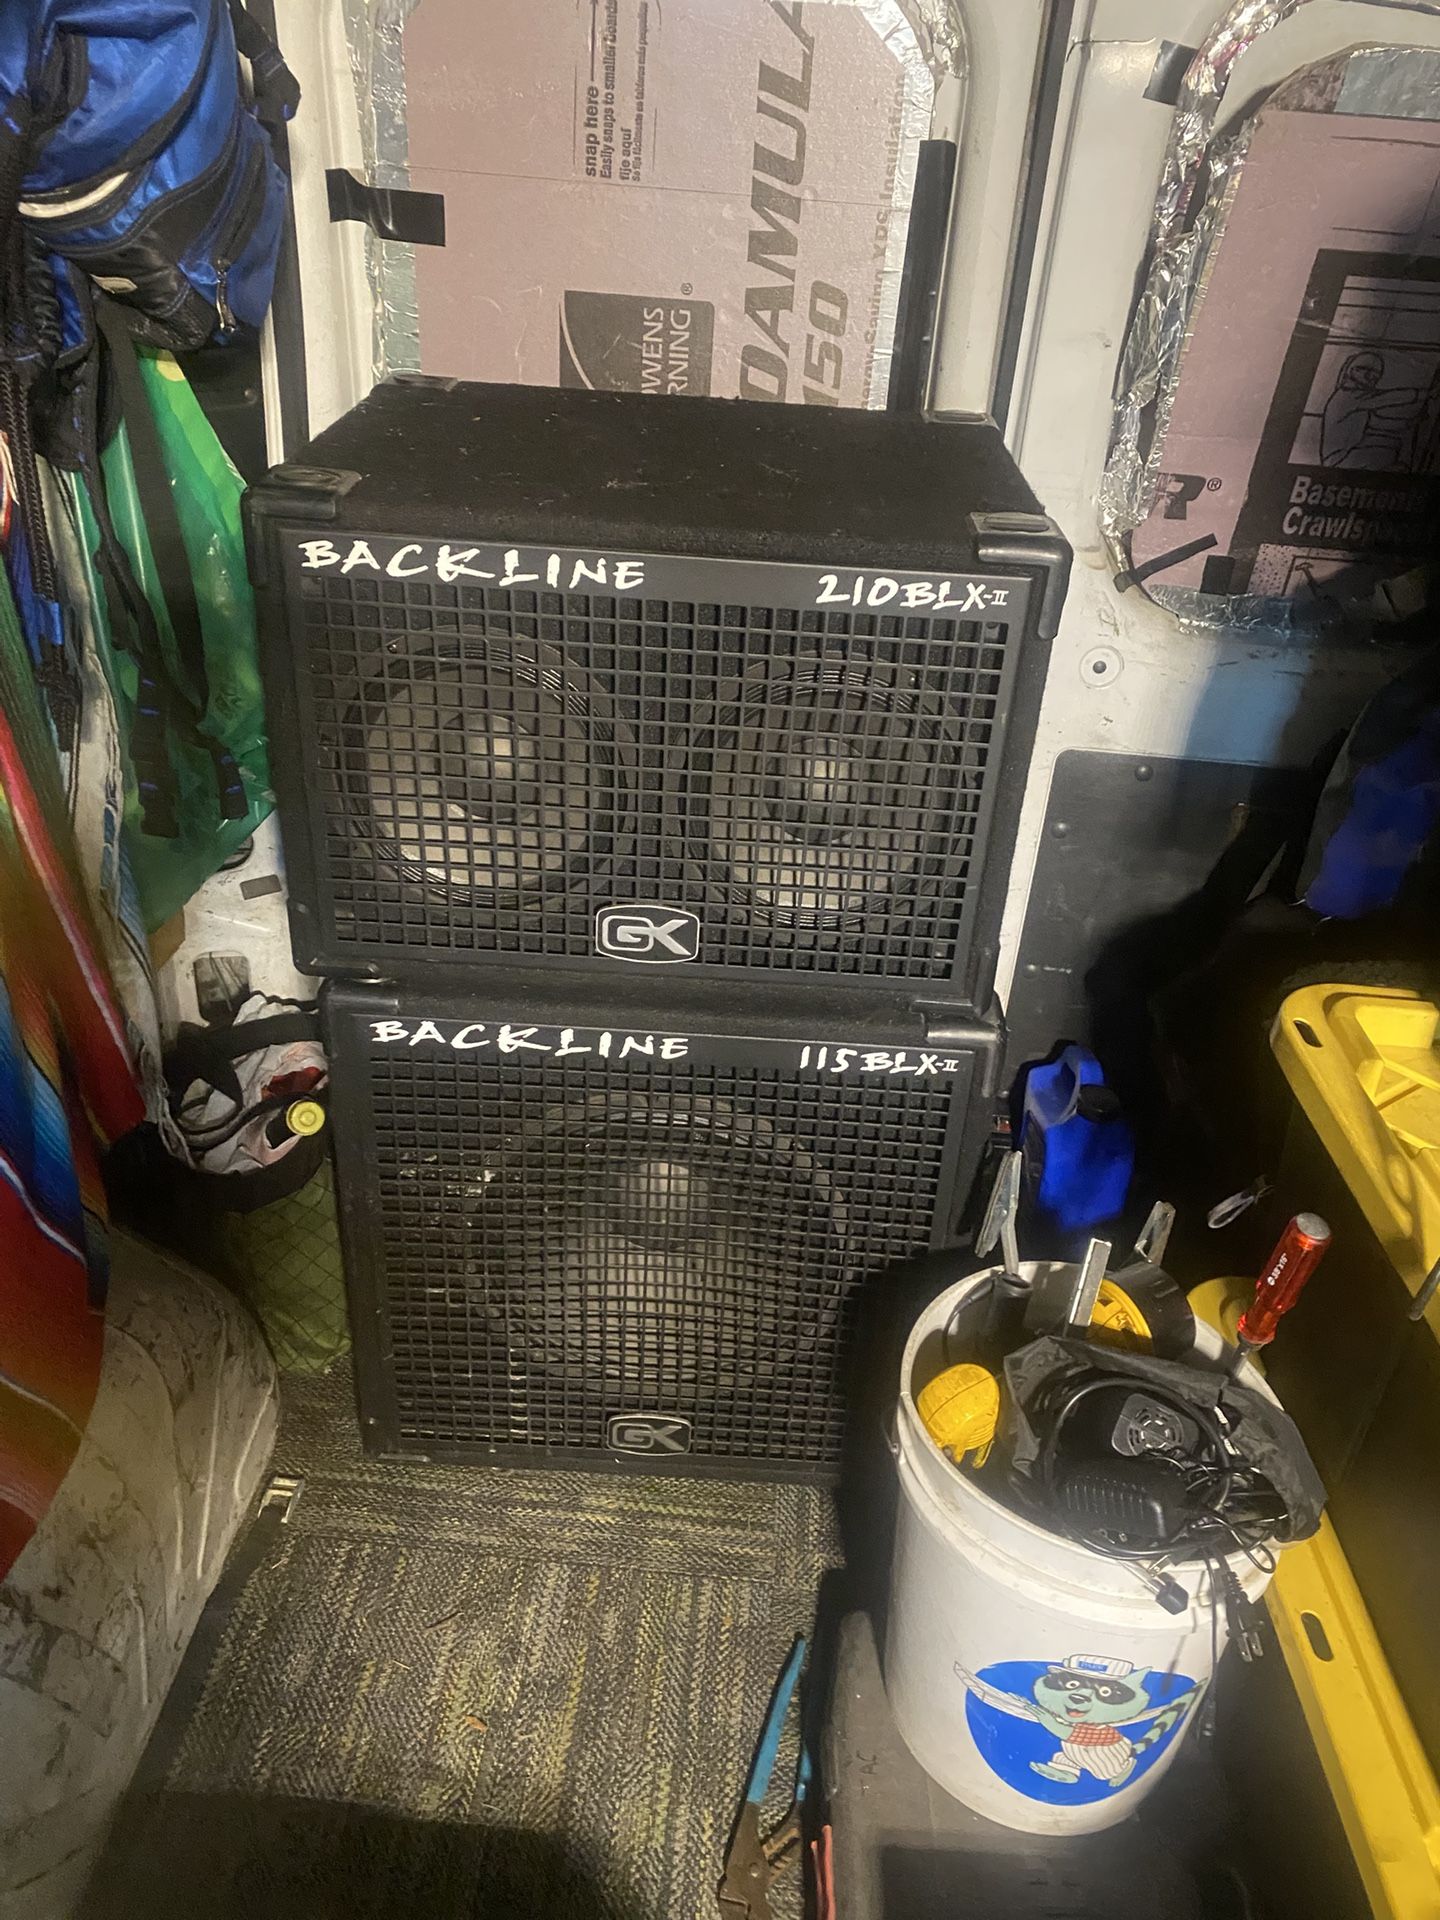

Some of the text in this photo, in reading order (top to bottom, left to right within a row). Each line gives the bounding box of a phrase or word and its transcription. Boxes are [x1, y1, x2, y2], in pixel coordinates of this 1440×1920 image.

[602, 46, 615, 90] smaller
[602, 92, 614, 105] to
[583, 85, 600, 177] snap here
[603, 107, 616, 143] snaps
[600, 144, 615, 179] Easily
[641, 307, 664, 394] WENS
[298, 540, 645, 590] BACKLINE
[601, 914, 692, 956] GK
[369, 1020, 689, 1060] BACKLINE
